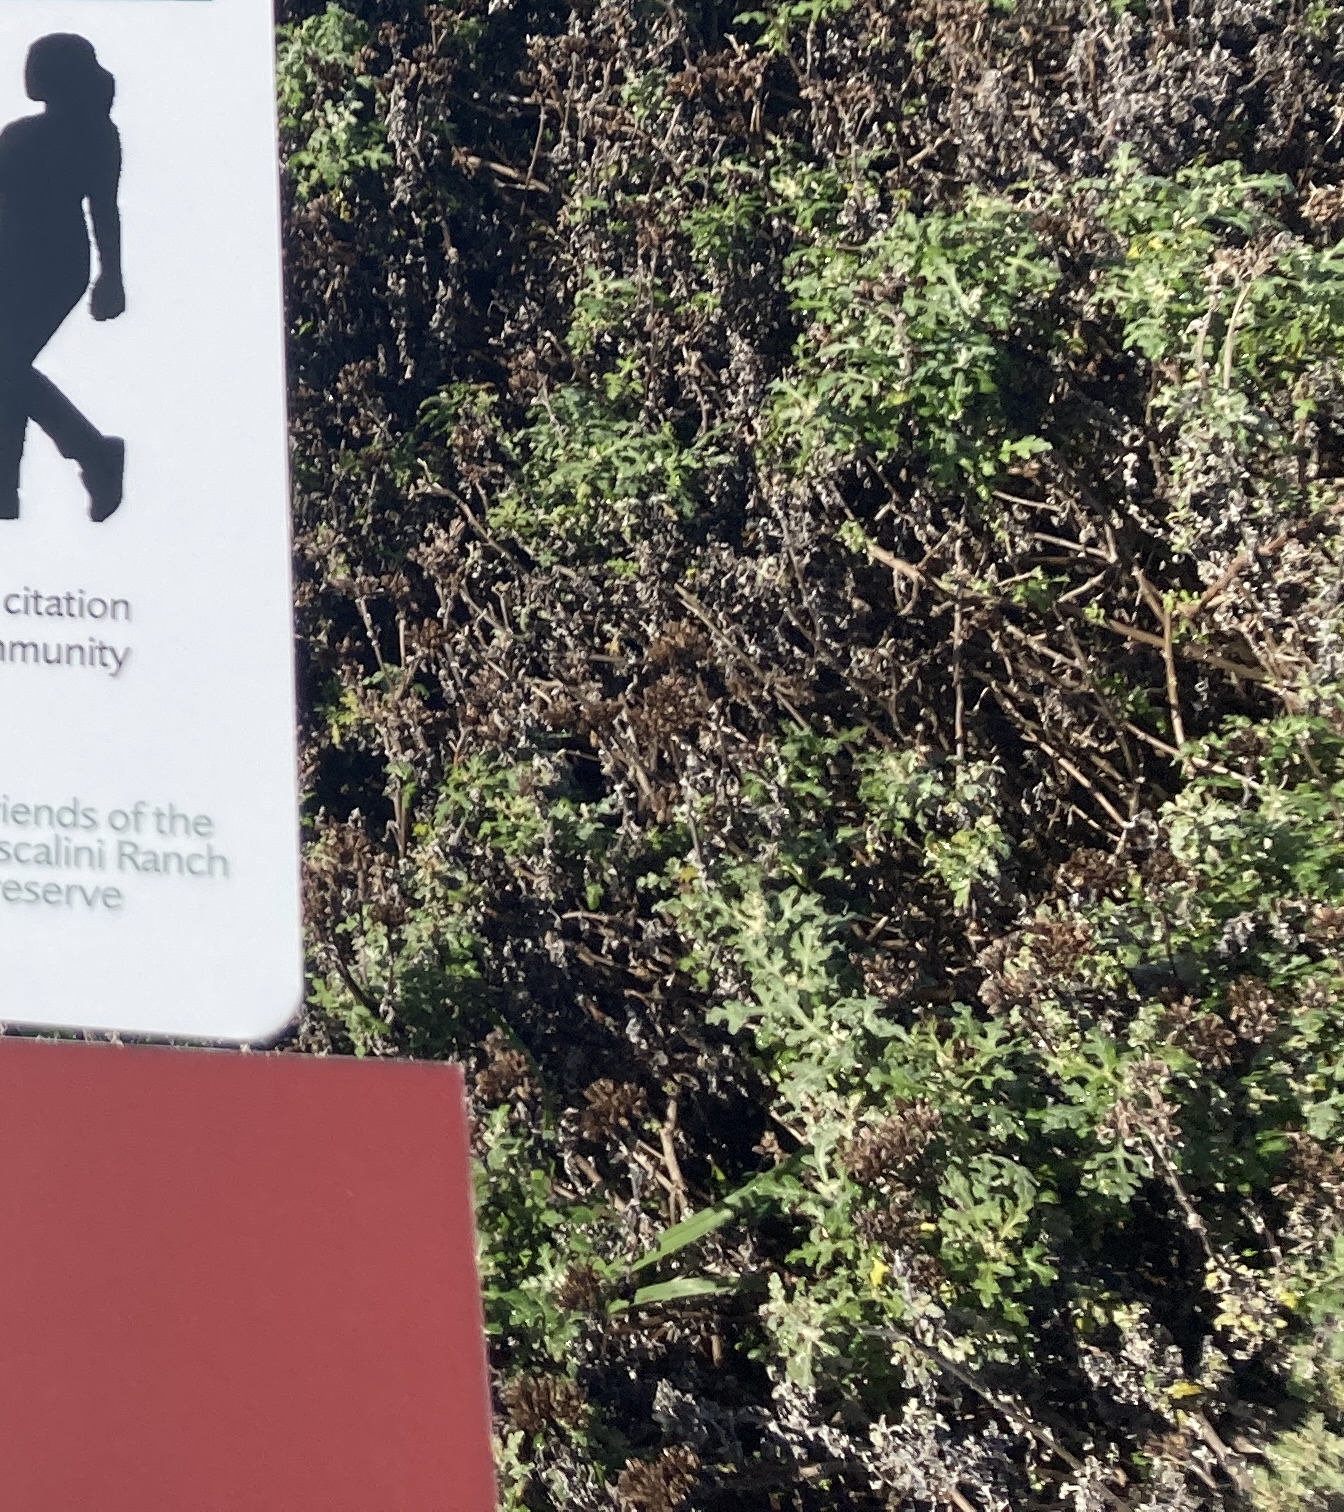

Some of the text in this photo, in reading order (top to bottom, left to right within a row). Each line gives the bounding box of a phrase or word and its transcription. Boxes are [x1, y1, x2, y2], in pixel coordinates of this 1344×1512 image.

[3, 586, 130, 621] citation
[108, 801, 148, 834] of
[152, 803, 215, 840] the
[117, 840, 230, 879] Ranch
